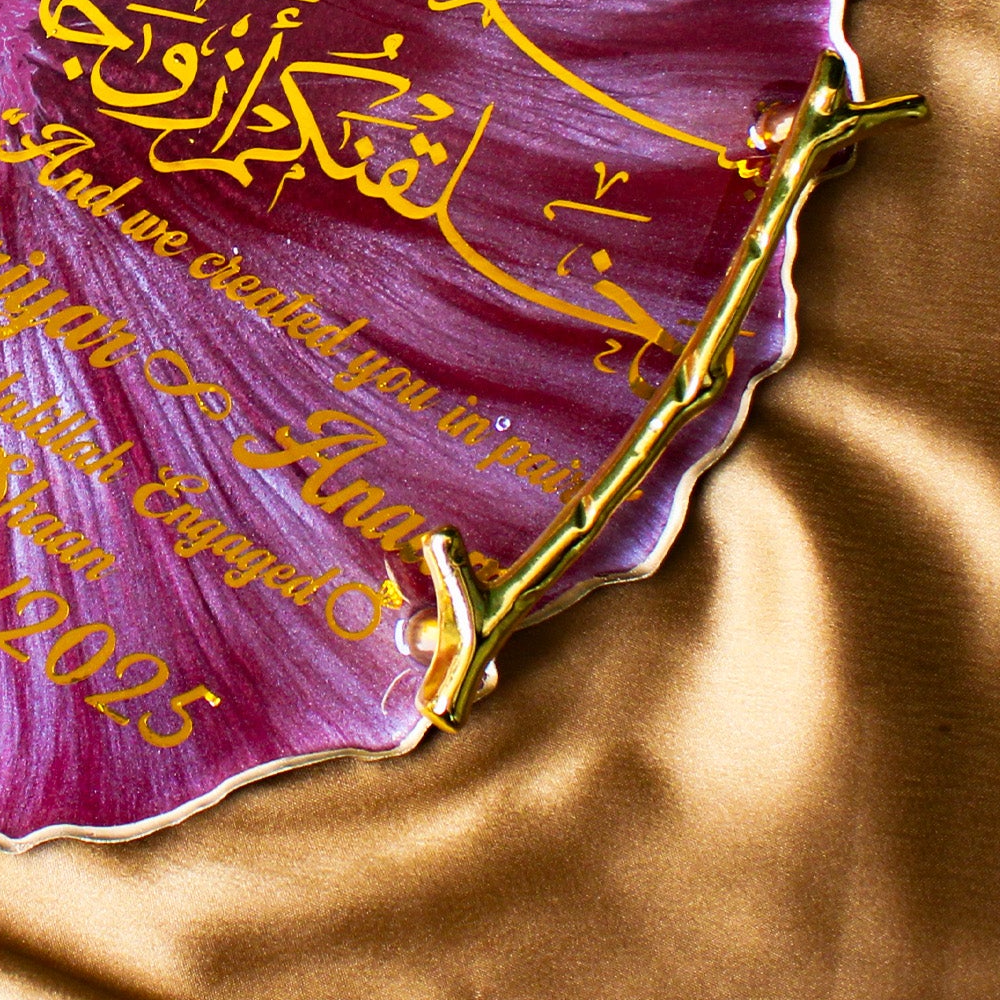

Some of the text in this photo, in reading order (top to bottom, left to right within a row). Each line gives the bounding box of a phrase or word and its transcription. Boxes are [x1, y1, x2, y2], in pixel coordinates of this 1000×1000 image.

[120, 209, 190, 257] we
[188, 252, 370, 356] created
[332, 349, 439, 412] you
[437, 396, 494, 446] in
[132, 466, 342, 606] Engaged
